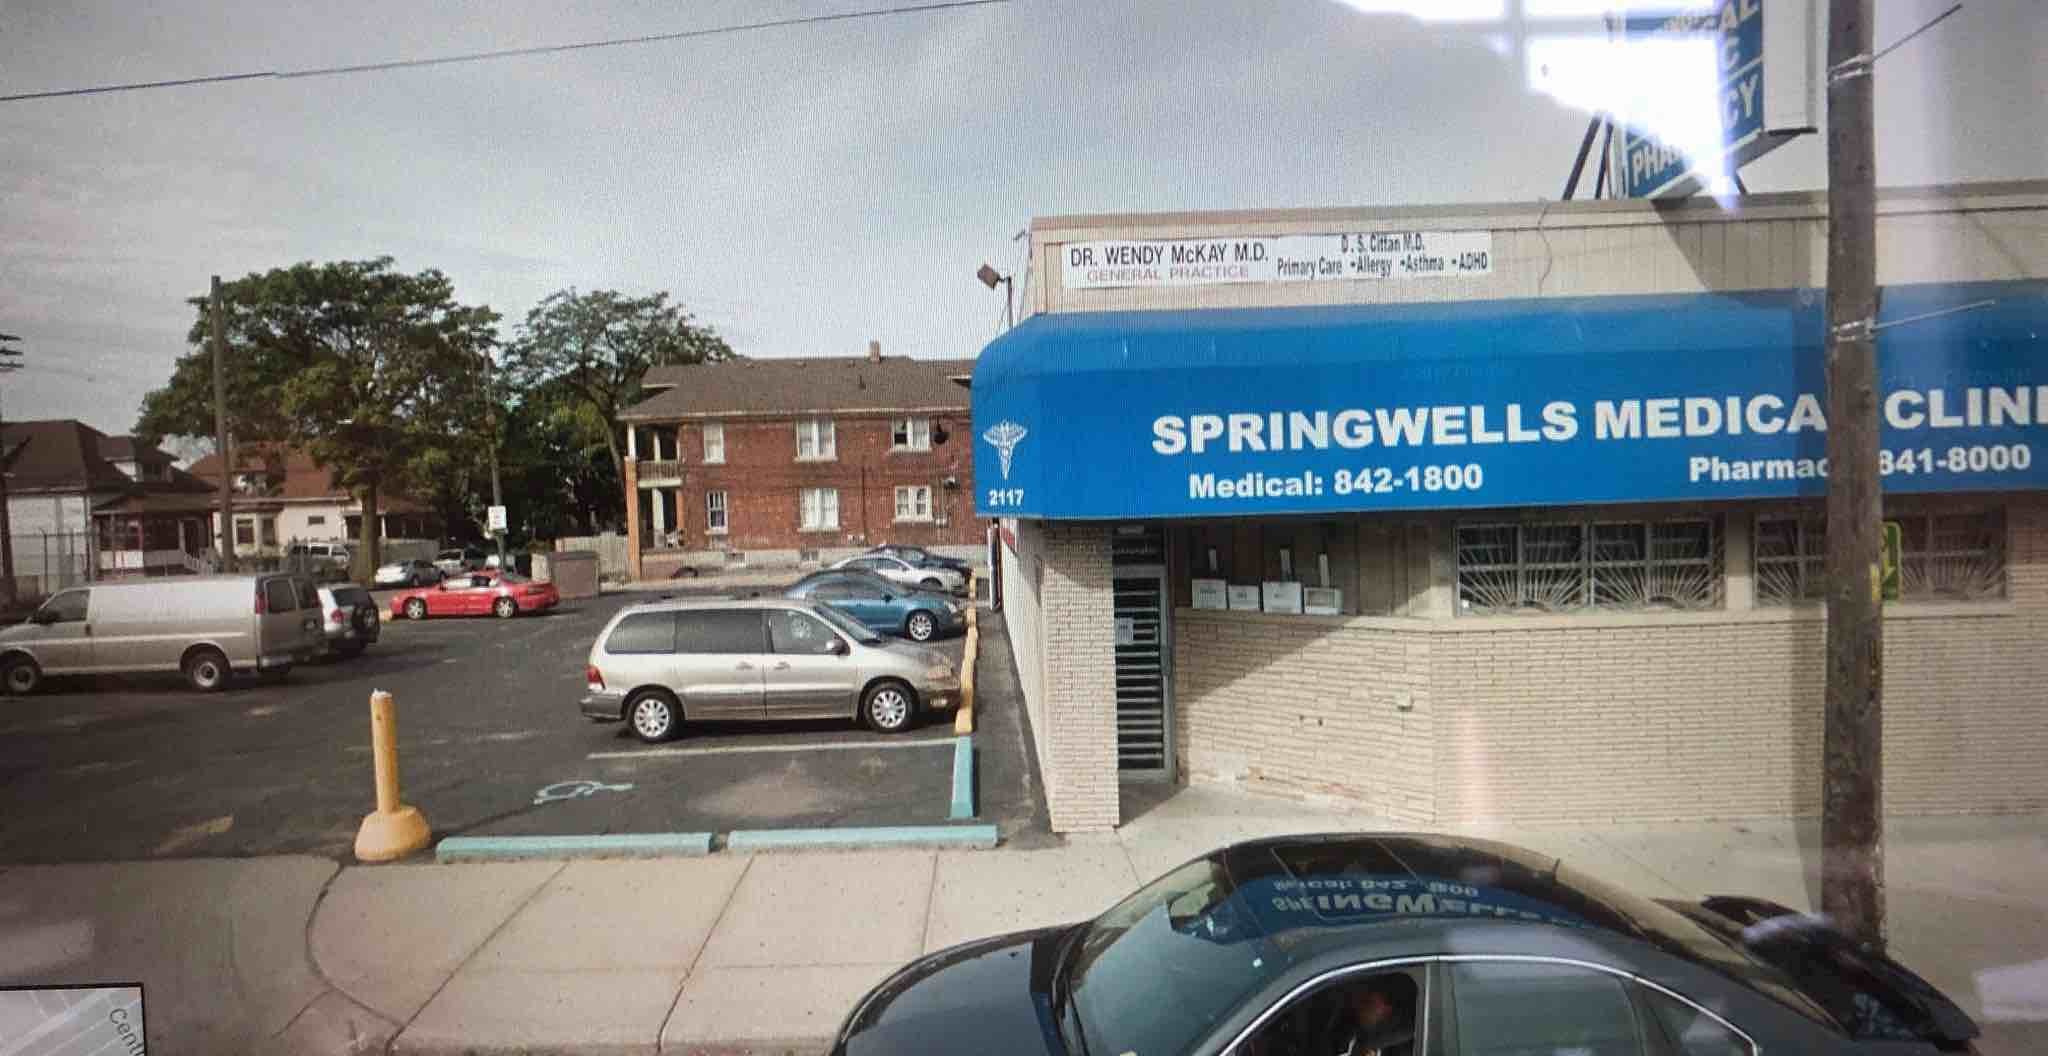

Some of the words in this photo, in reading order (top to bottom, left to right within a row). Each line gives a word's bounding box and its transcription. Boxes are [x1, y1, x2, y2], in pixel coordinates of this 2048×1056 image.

[1070, 247, 1098, 267] DR.
[1104, 245, 1165, 265] WENDY
[1171, 243, 1228, 264] McKAY
[1234, 242, 1269, 262] M.D.
[1277, 256, 1316, 279] Primary
[1318, 255, 1343, 275] Care
[1087, 266, 1161, 283] GENERAL
[1169, 264, 1249, 281] PRACTICE
[1152, 401, 1580, 456] SPRINGWELLS
[1594, 393, 1829, 441] MEDICA
[1188, 470, 1323, 499] Medical:
[1333, 463, 1484, 495] 842-1800
[1689, 455, 1830, 483] Pharmac
[988, 488, 1025, 507] 2117
